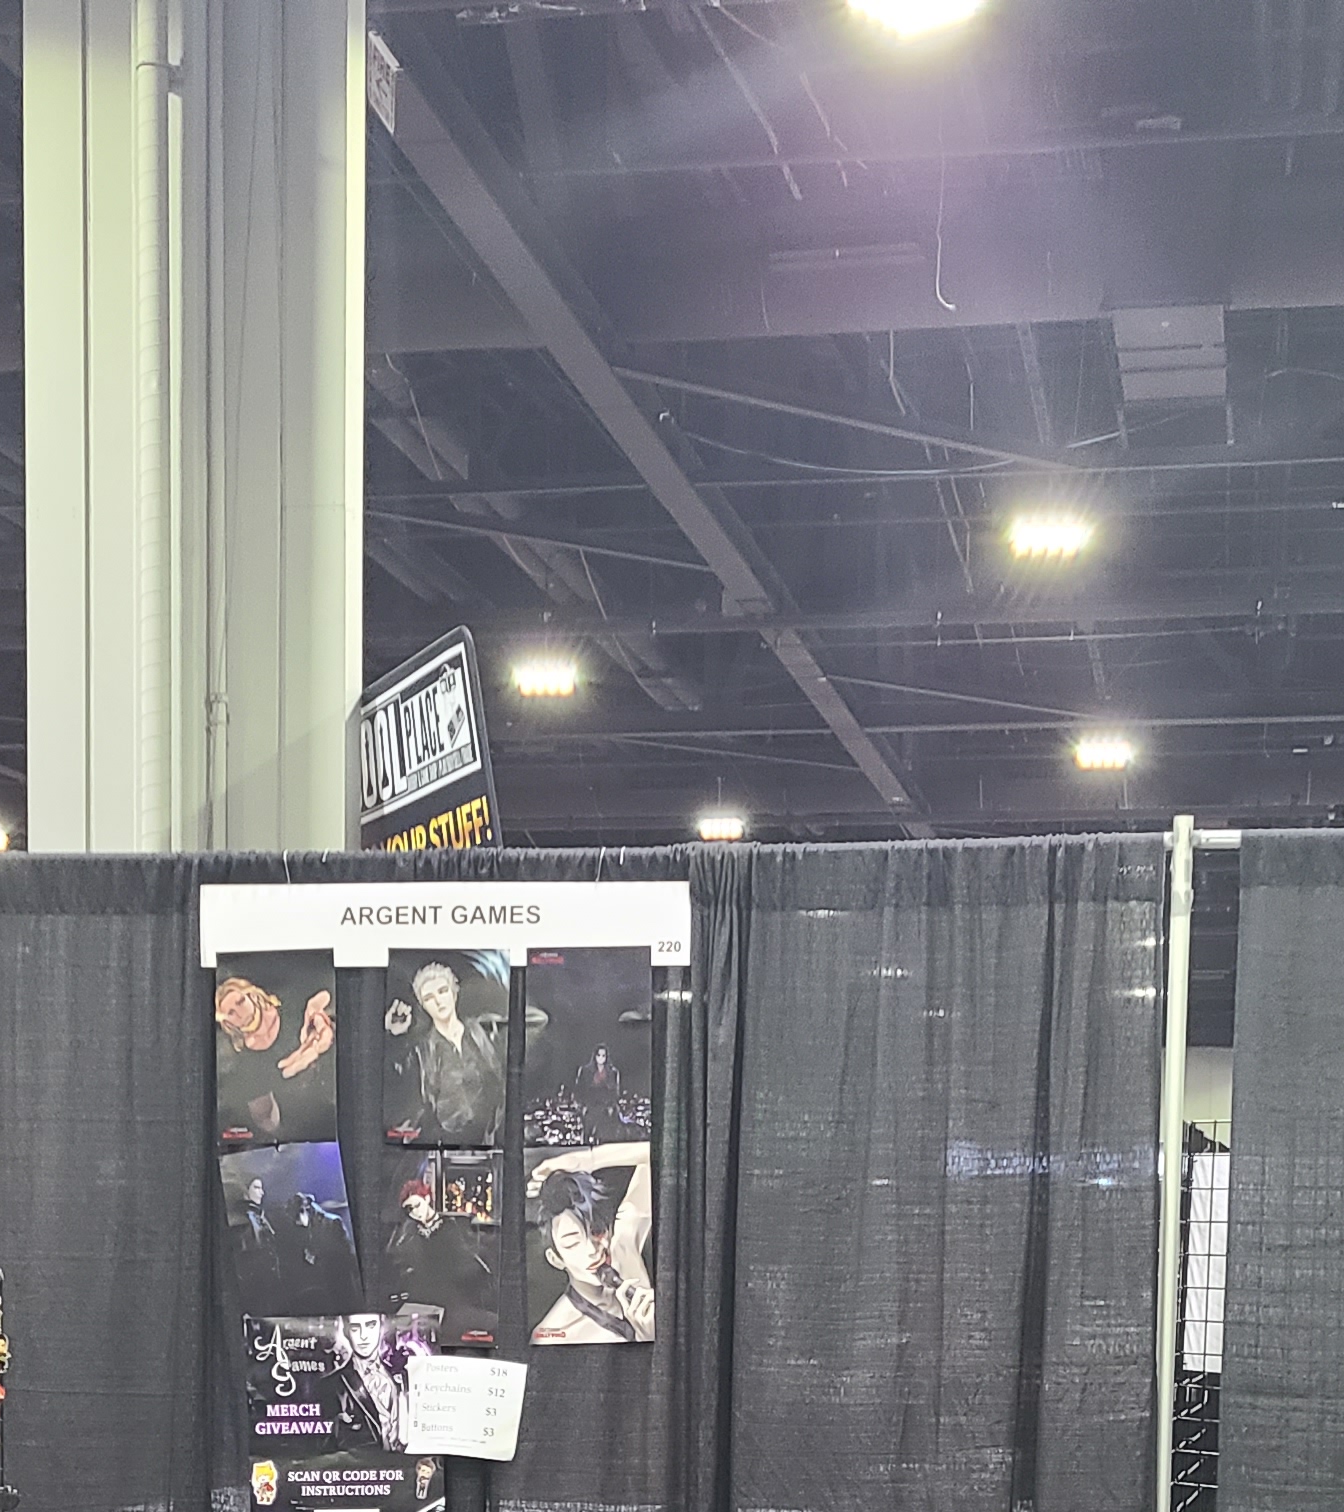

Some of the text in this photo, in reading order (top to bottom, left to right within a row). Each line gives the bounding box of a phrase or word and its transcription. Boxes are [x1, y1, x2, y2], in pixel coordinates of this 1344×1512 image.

[360, 700, 408, 808] OOL
[403, 687, 445, 771] PLACE
[428, 796, 492, 852] STUFF!
[340, 905, 541, 926] ARGENT GAMES
[657, 940, 682, 953] 220
[254, 1324, 318, 1370] Argent
[425, 1362, 459, 1373] Posters
[272, 1360, 326, 1396] Games
[423, 1382, 507, 1399] Keychains $12
[266, 1403, 321, 1417] MERCH
[254, 1420, 335, 1435] GIVEAWAY
[287, 1469, 405, 1483] SCAN QR CODE FOR
[300, 1484, 392, 1497] INSTRUCTIONS
